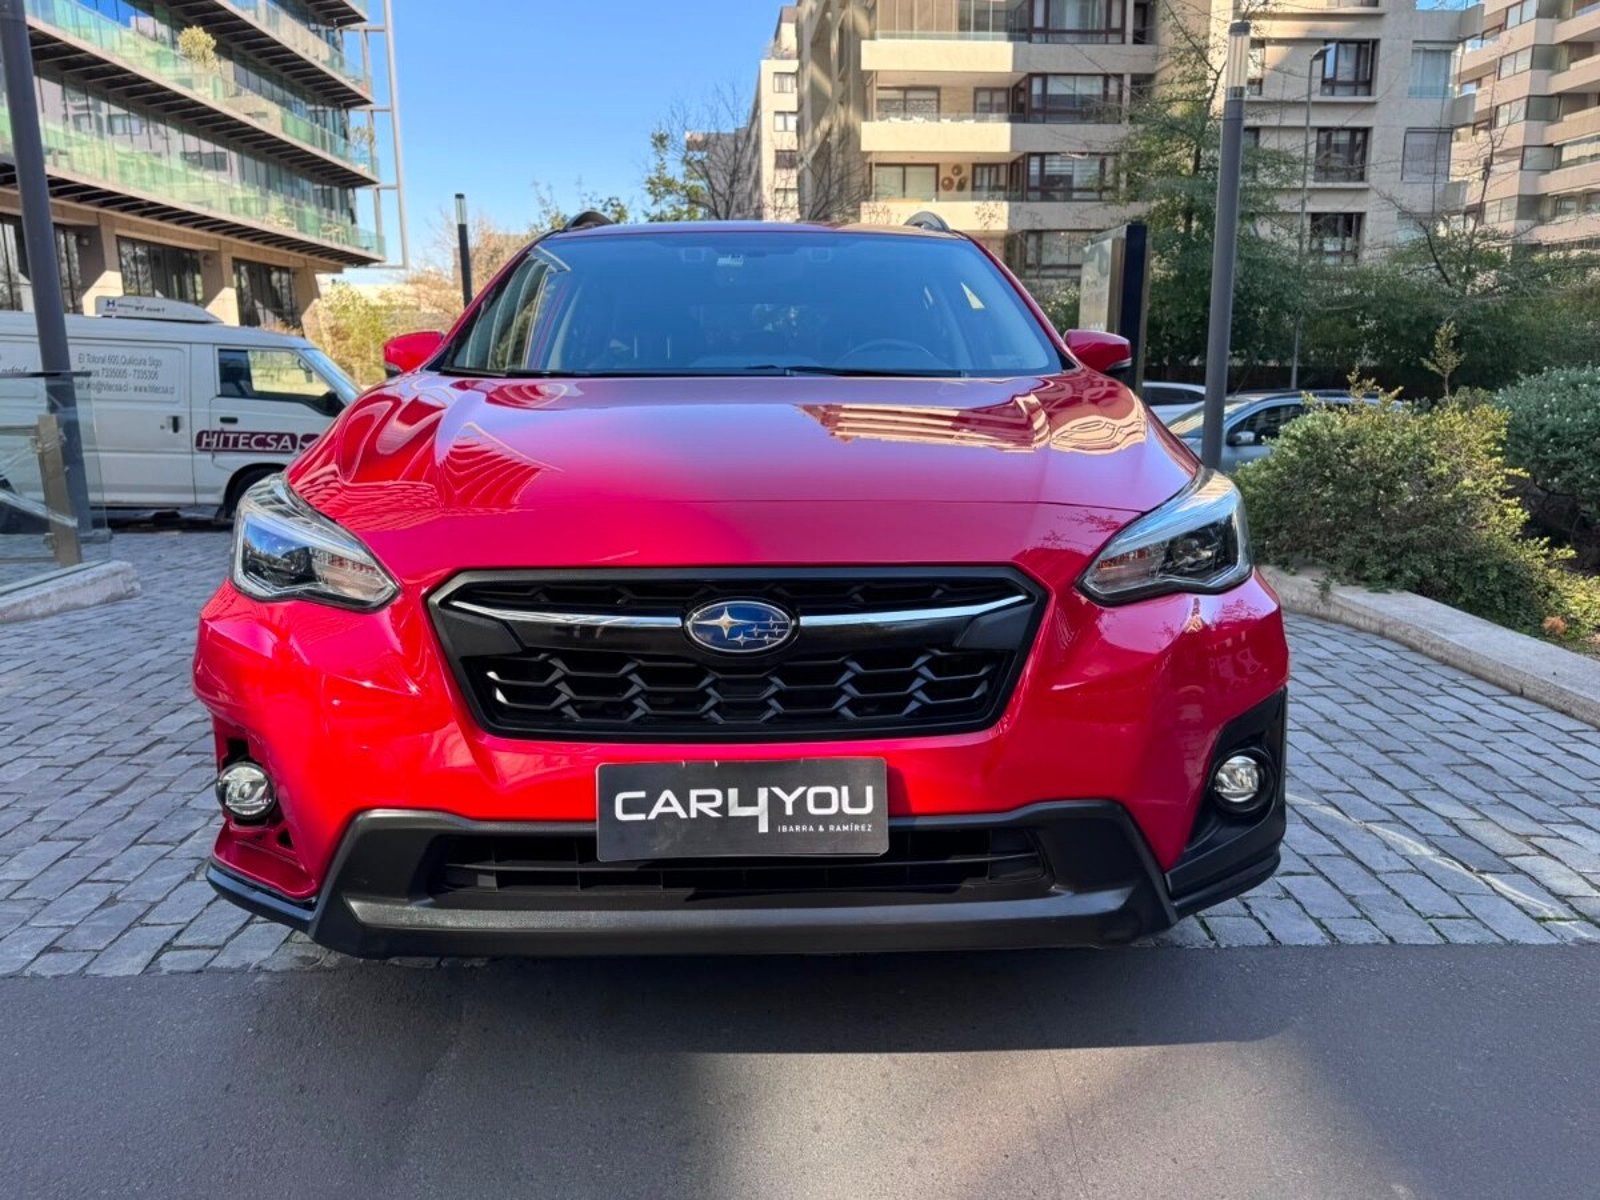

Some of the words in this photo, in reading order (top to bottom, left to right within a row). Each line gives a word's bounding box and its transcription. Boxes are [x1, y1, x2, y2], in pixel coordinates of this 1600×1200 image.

[202, 433, 293, 450] HITECSA
[614, 785, 874, 833] CAR4YOU
[777, 824, 815, 833] IBARRA
[828, 822, 873, 832] RAMÍREZ
